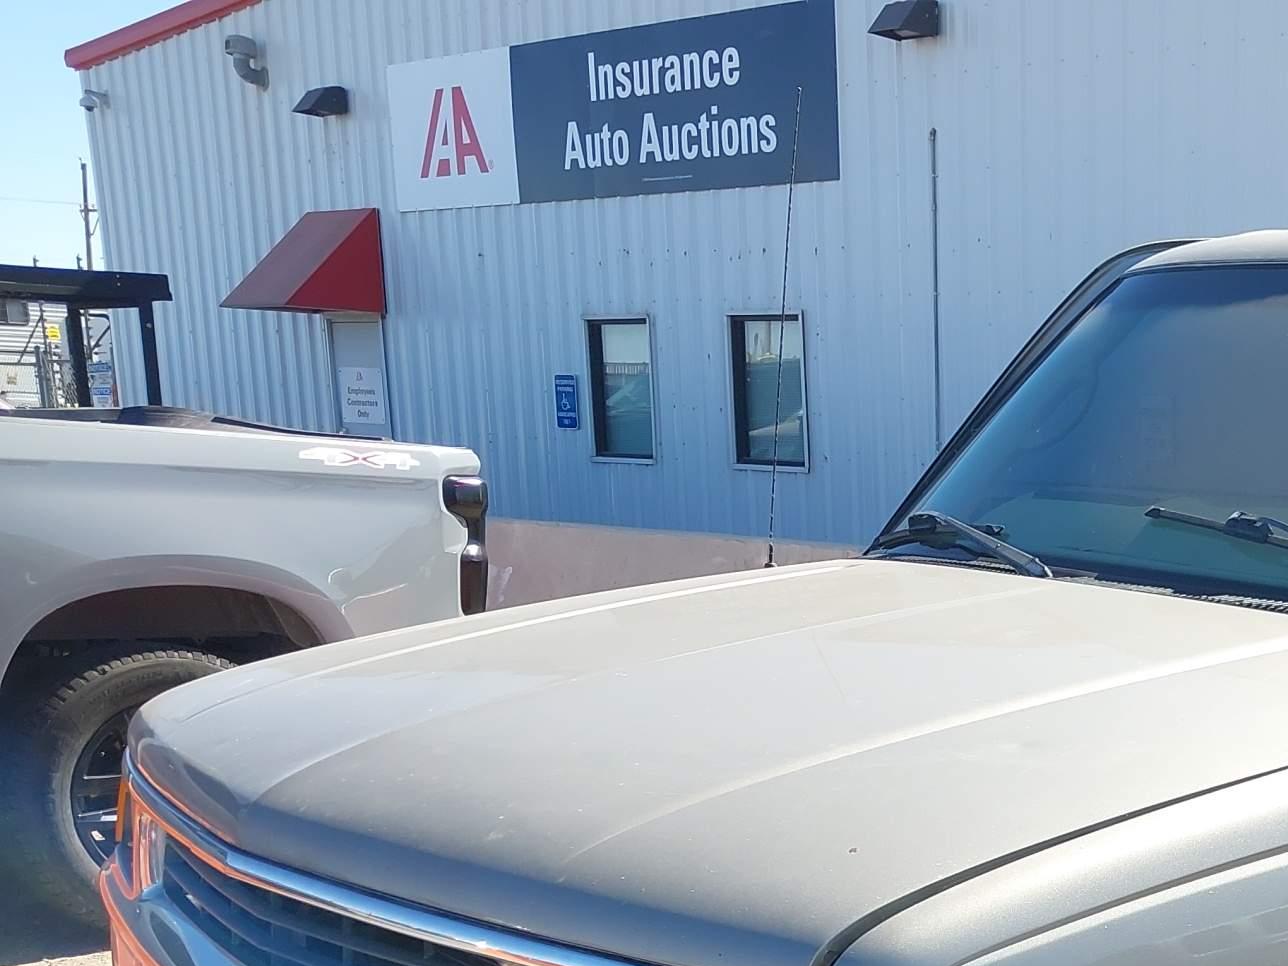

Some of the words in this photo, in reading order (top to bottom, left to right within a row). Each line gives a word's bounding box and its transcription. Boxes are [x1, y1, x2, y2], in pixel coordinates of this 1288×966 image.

[587, 46, 741, 102] Insurance
[564, 121, 630, 170] Auto
[640, 105, 778, 164] Auctions
